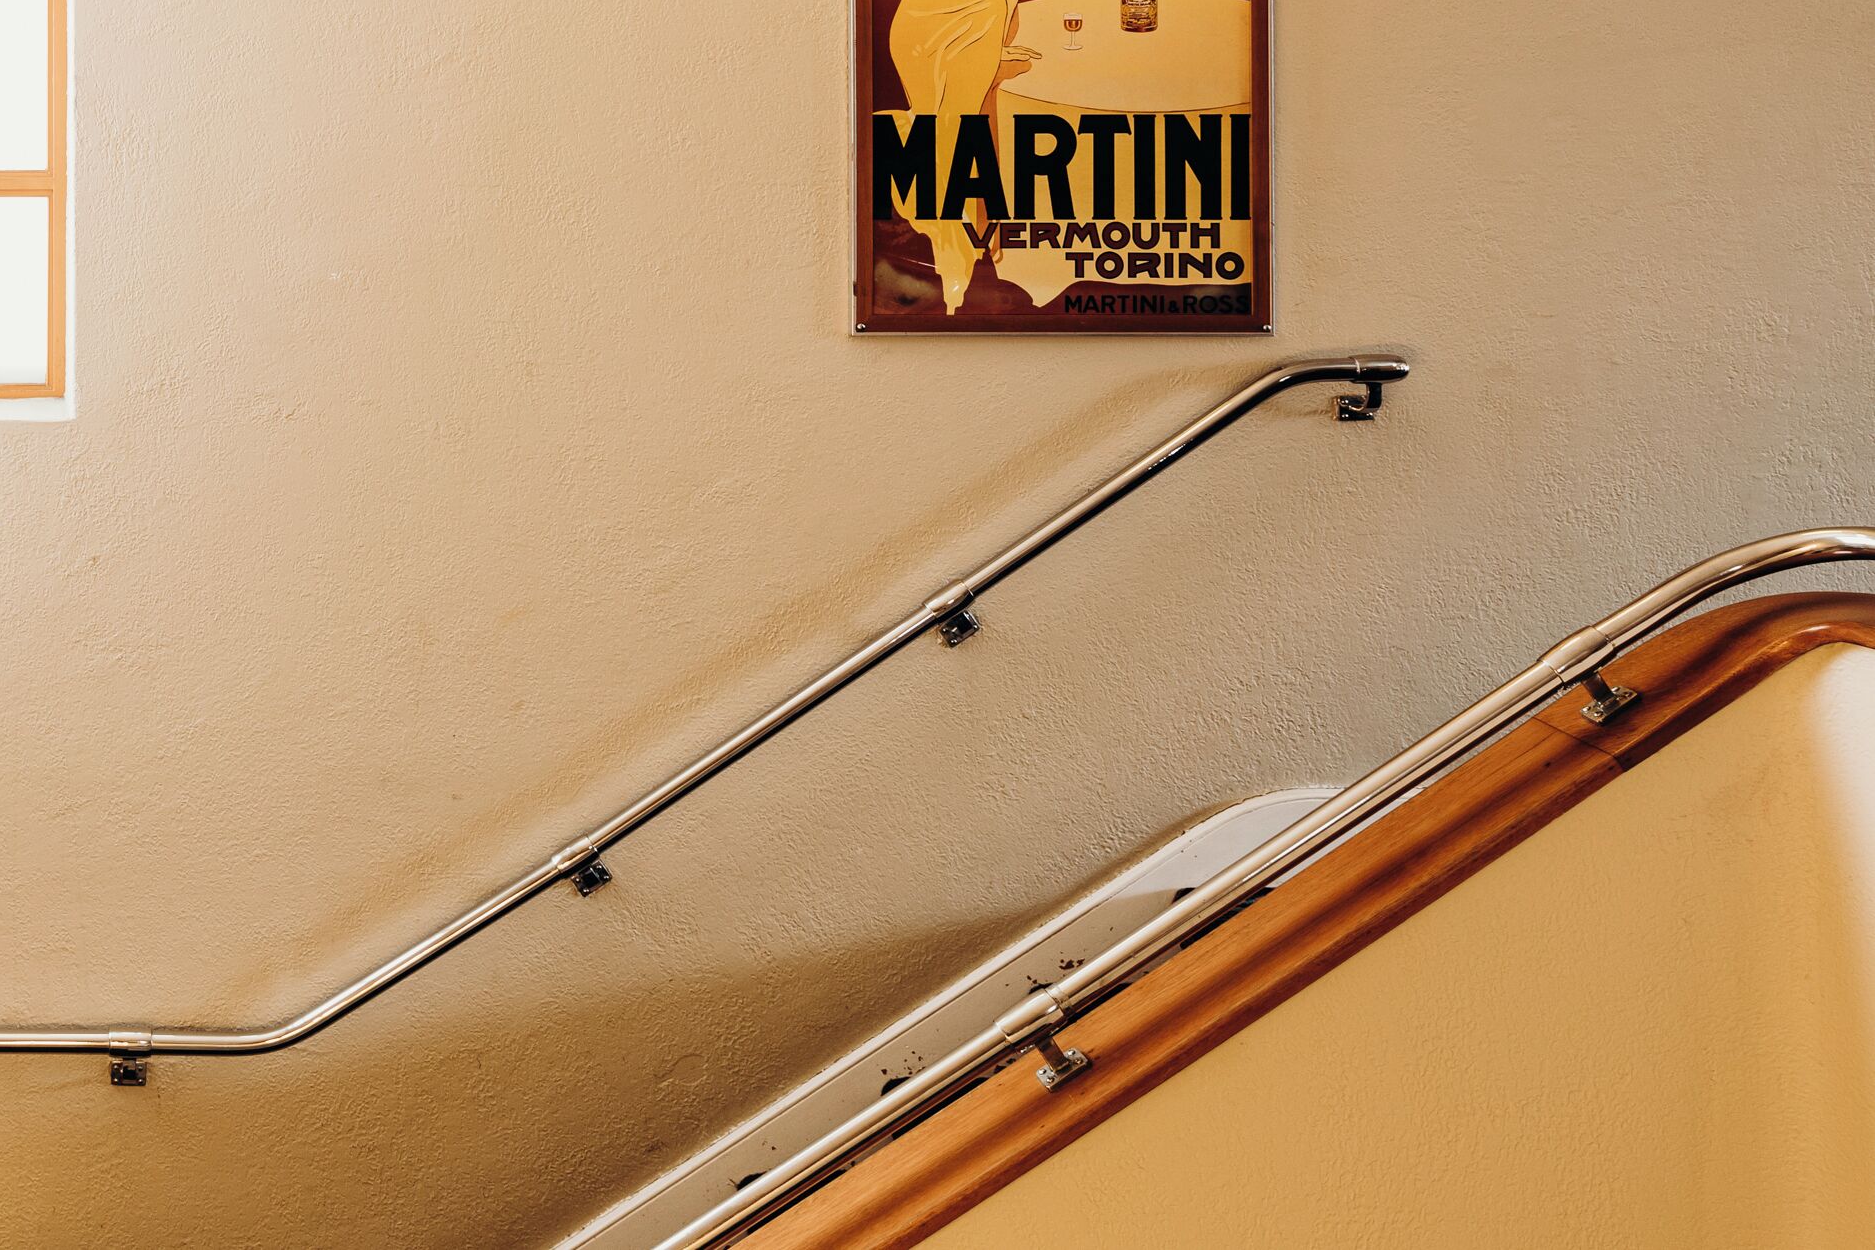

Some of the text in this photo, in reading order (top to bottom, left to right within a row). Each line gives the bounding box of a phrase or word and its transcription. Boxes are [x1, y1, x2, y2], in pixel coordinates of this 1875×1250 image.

[872, 114, 1252, 220] MARTINI
[961, 222, 1221, 249] VERMOUTH
[1065, 251, 1245, 279] TORINO
